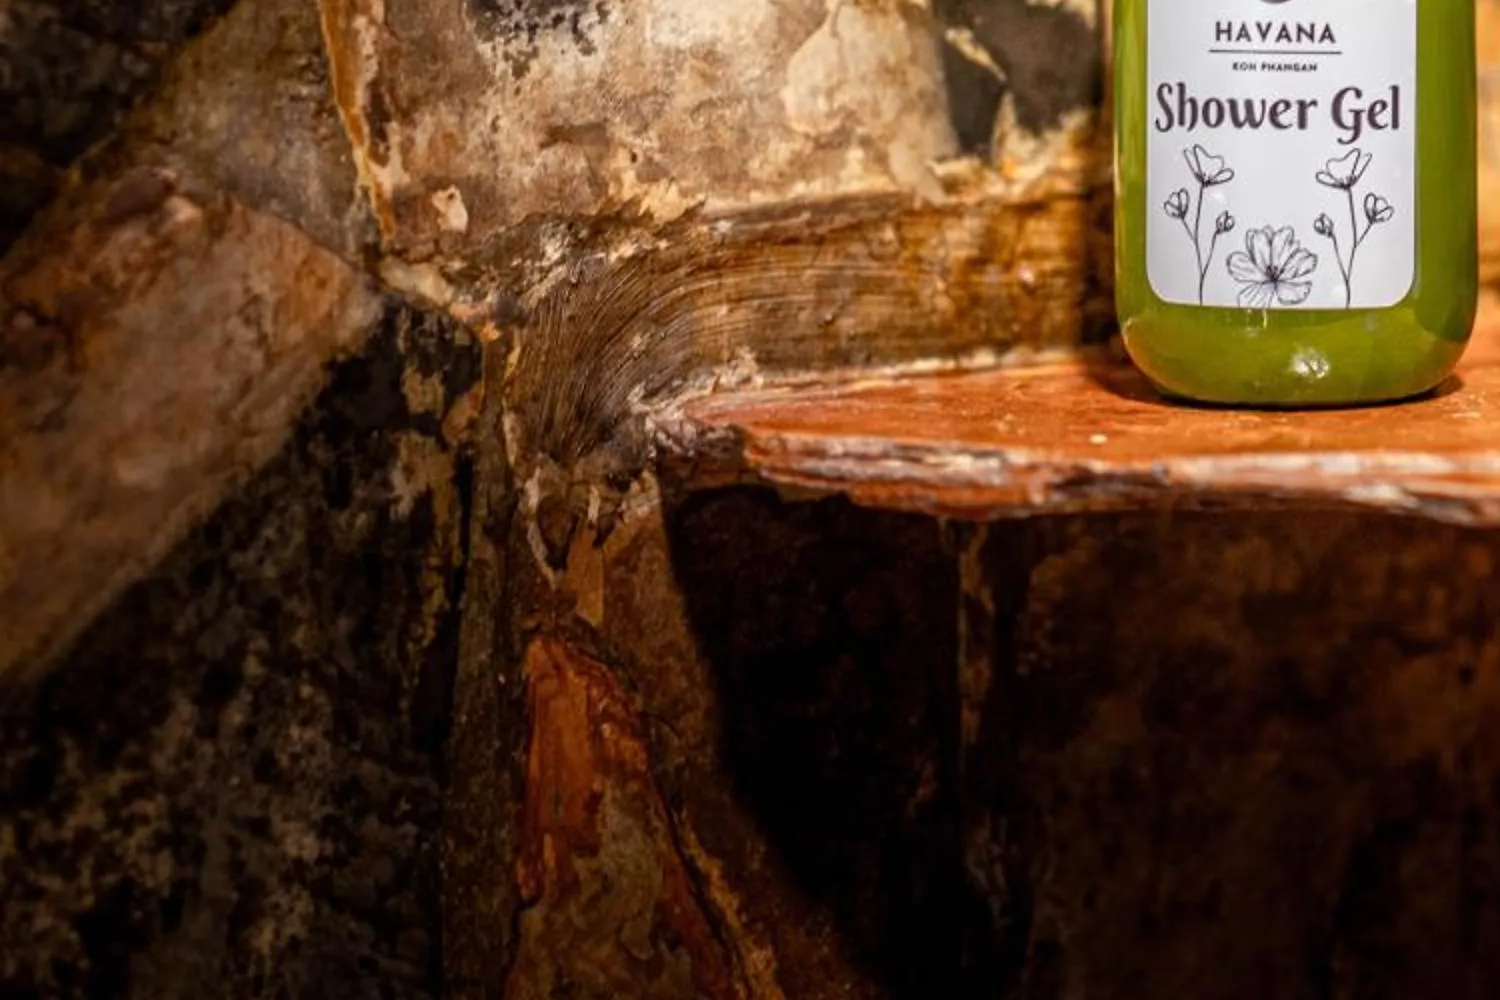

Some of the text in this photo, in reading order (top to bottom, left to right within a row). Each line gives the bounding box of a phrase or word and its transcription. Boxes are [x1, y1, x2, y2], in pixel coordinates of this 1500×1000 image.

[1215, 21, 1336, 43] HAVANA
[1261, 62, 1318, 73] PHANGAN
[1155, 82, 1400, 145] Shower Gel
